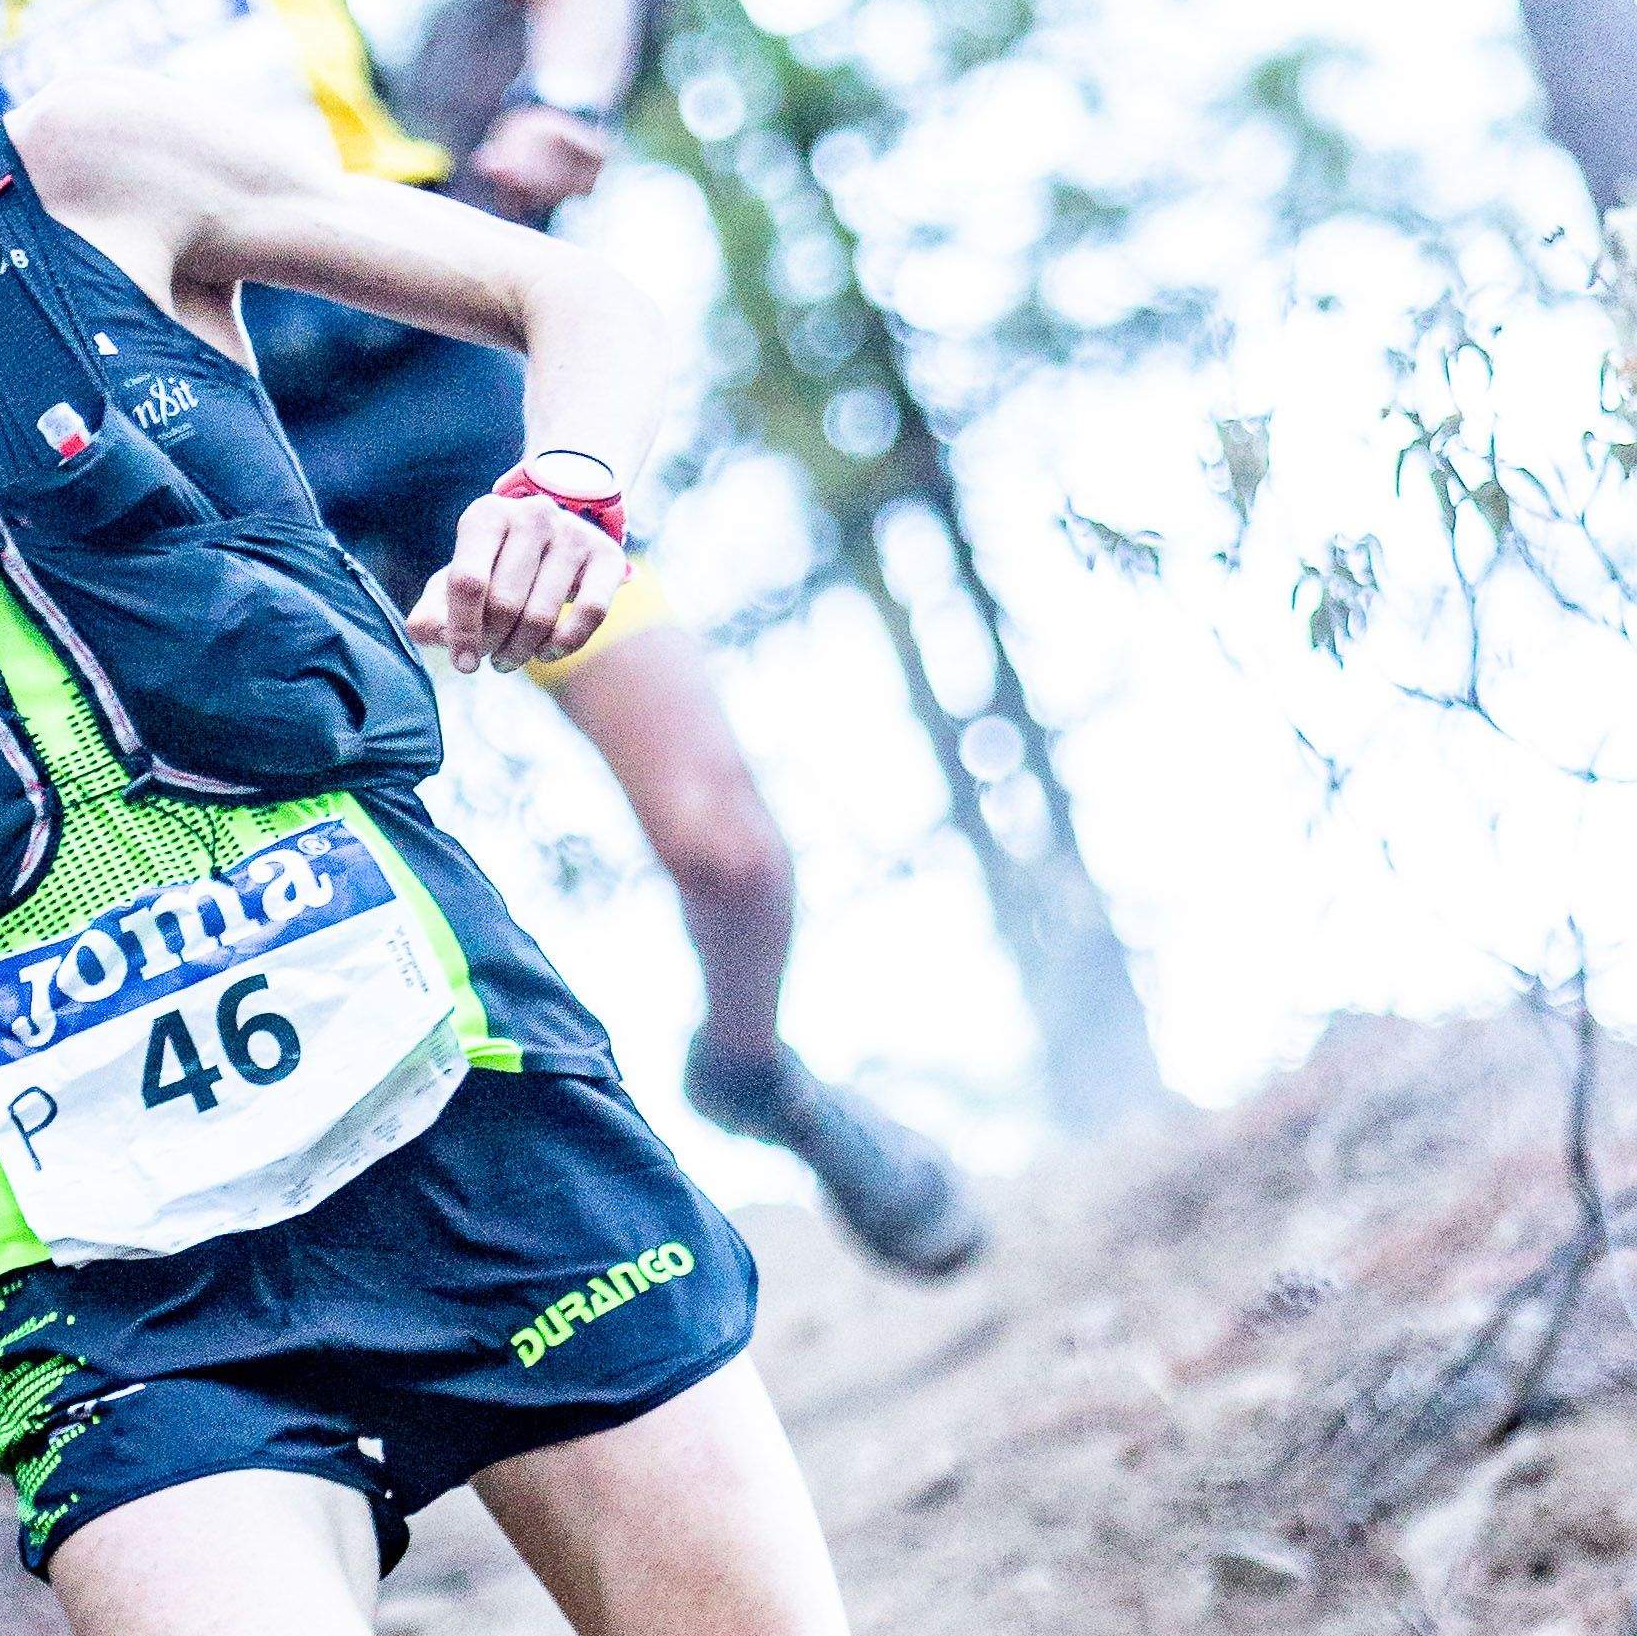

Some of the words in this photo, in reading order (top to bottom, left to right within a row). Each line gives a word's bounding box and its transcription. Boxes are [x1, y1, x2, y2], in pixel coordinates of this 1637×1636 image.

[140, 972, 302, 1114] 46
[7, 1085, 59, 1171] P
[509, 1240, 696, 1369] DURANGO
